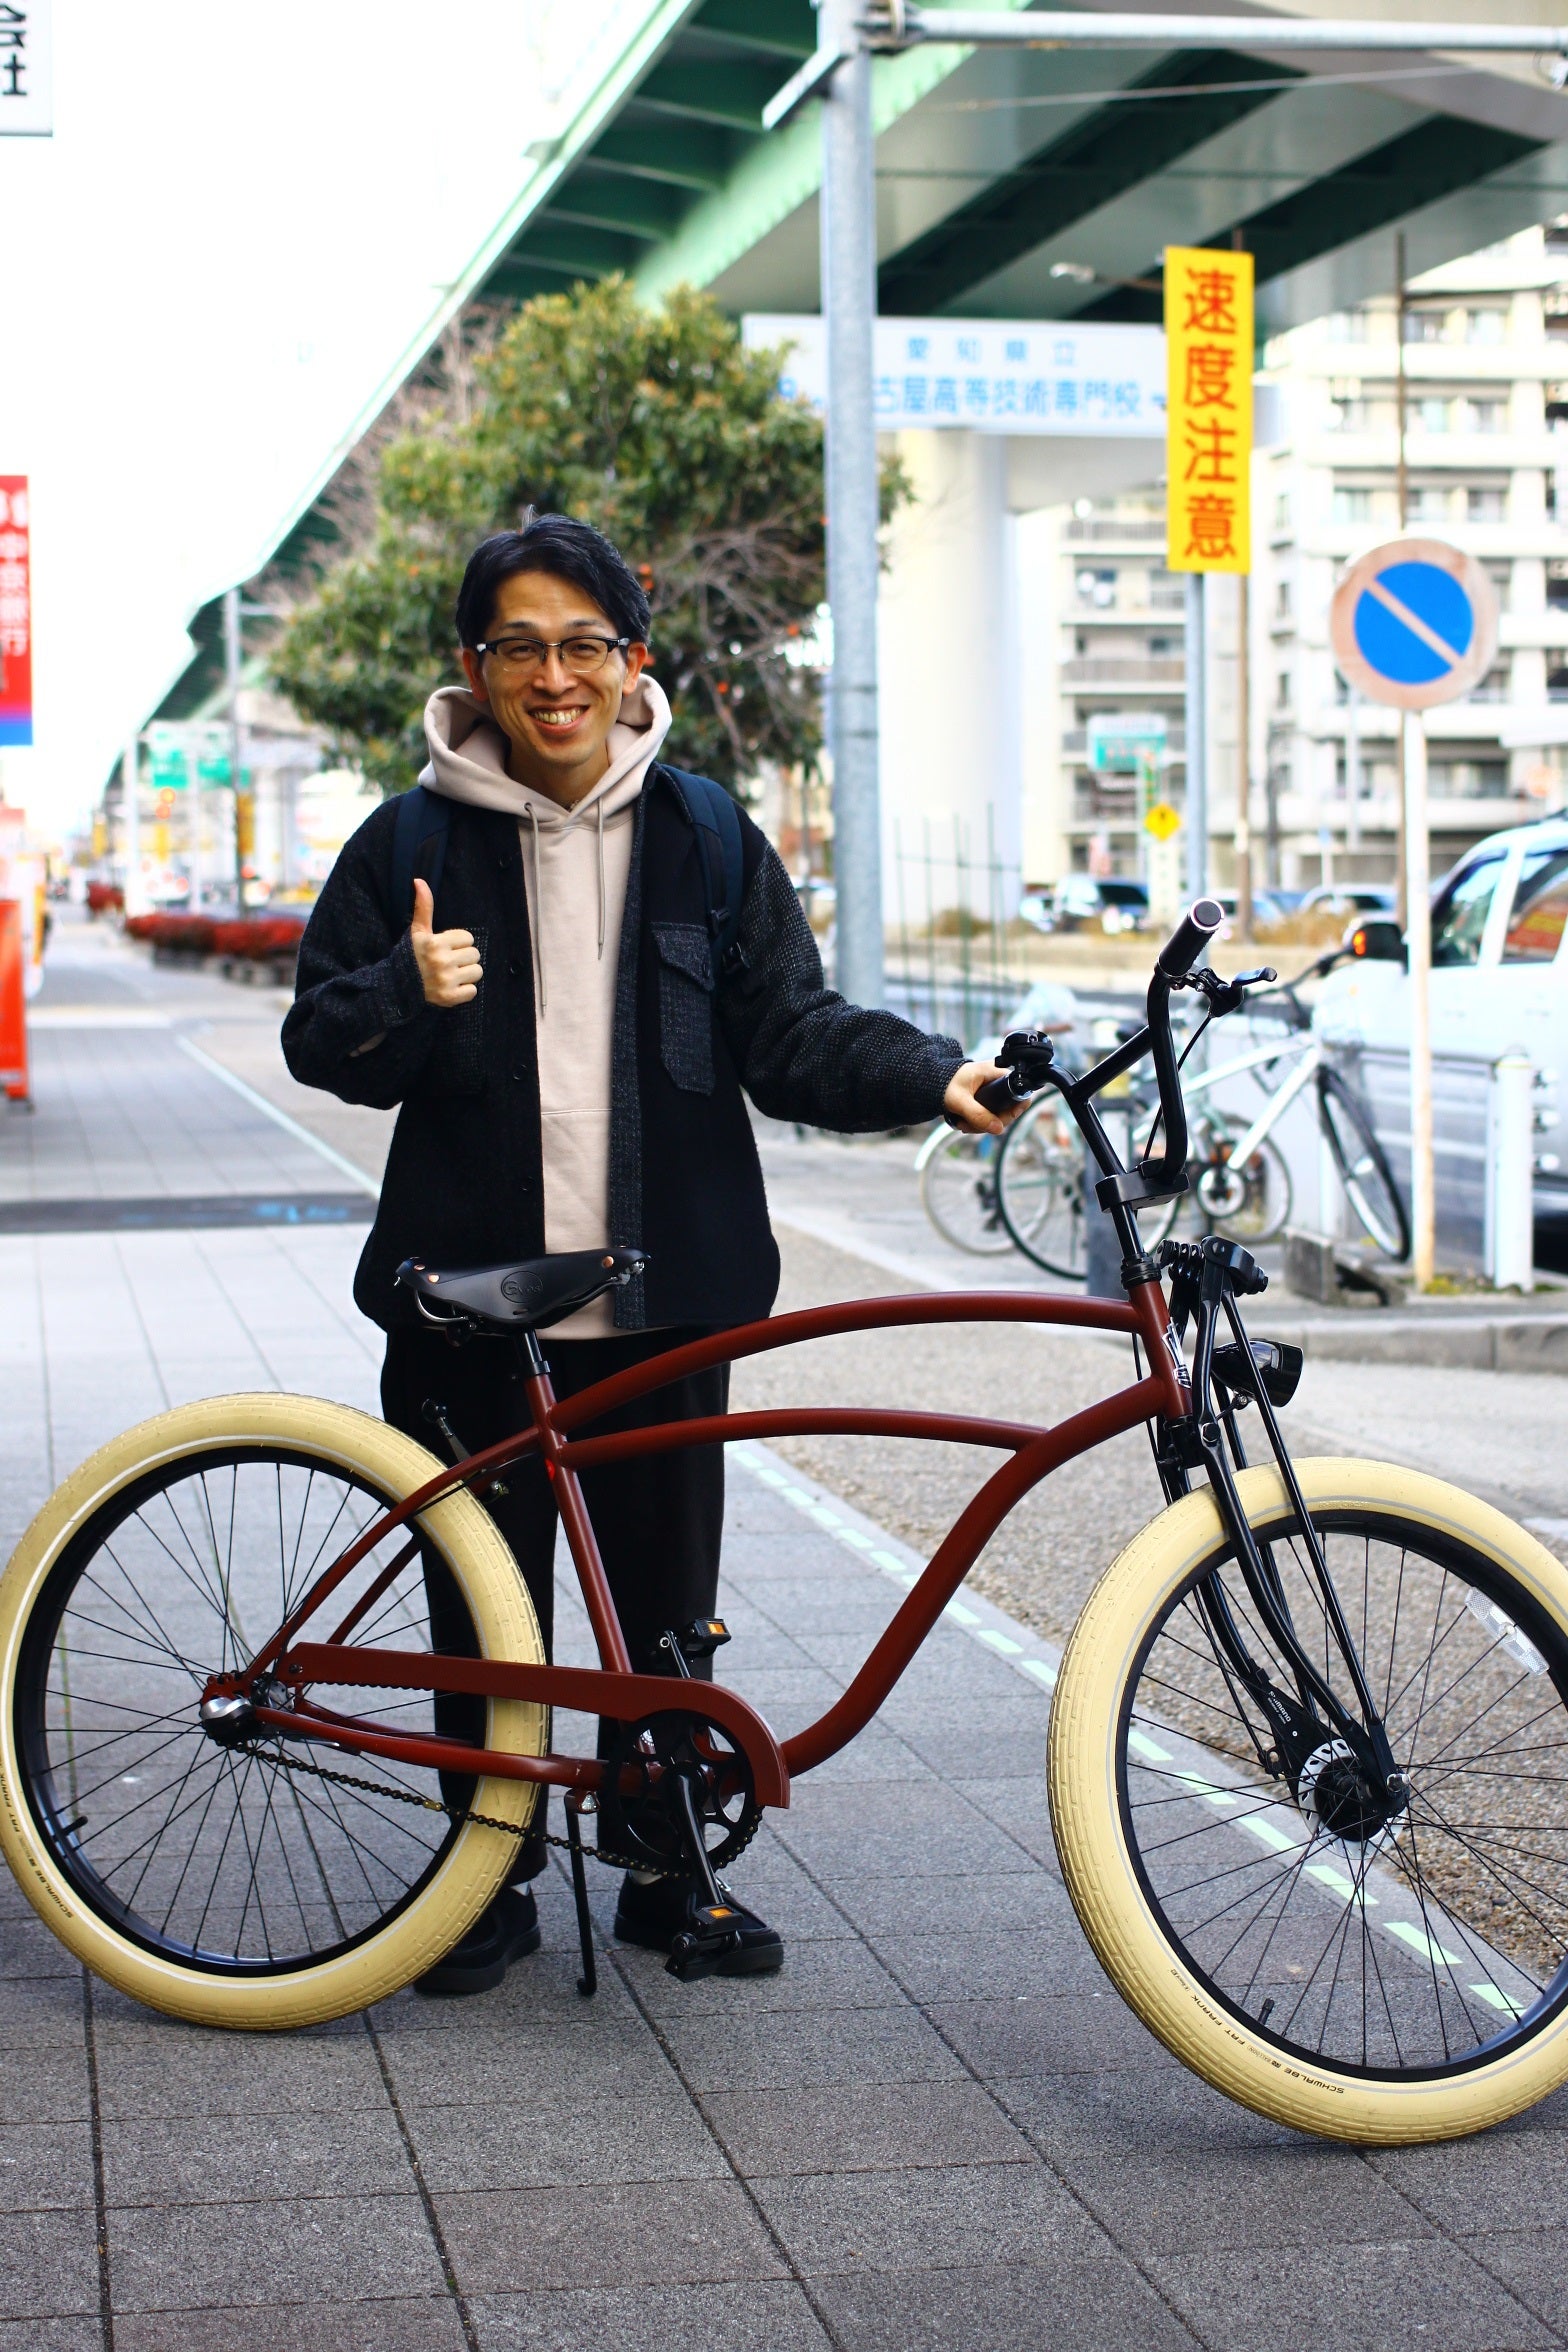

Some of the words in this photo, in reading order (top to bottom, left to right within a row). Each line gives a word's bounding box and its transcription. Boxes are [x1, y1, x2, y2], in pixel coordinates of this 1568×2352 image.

[907, 336, 1077, 367] 愛知県立
[1183, 266, 1238, 559] 速度注意
[9, 1813, 21, 1833] FAT
[35, 1869, 74, 1919] SCHWALBE
[1191, 1995, 1222, 2026] FRANK
[1223, 2028, 1246, 2046] FAT
[1283, 2067, 1345, 2095] SCHWALBE
